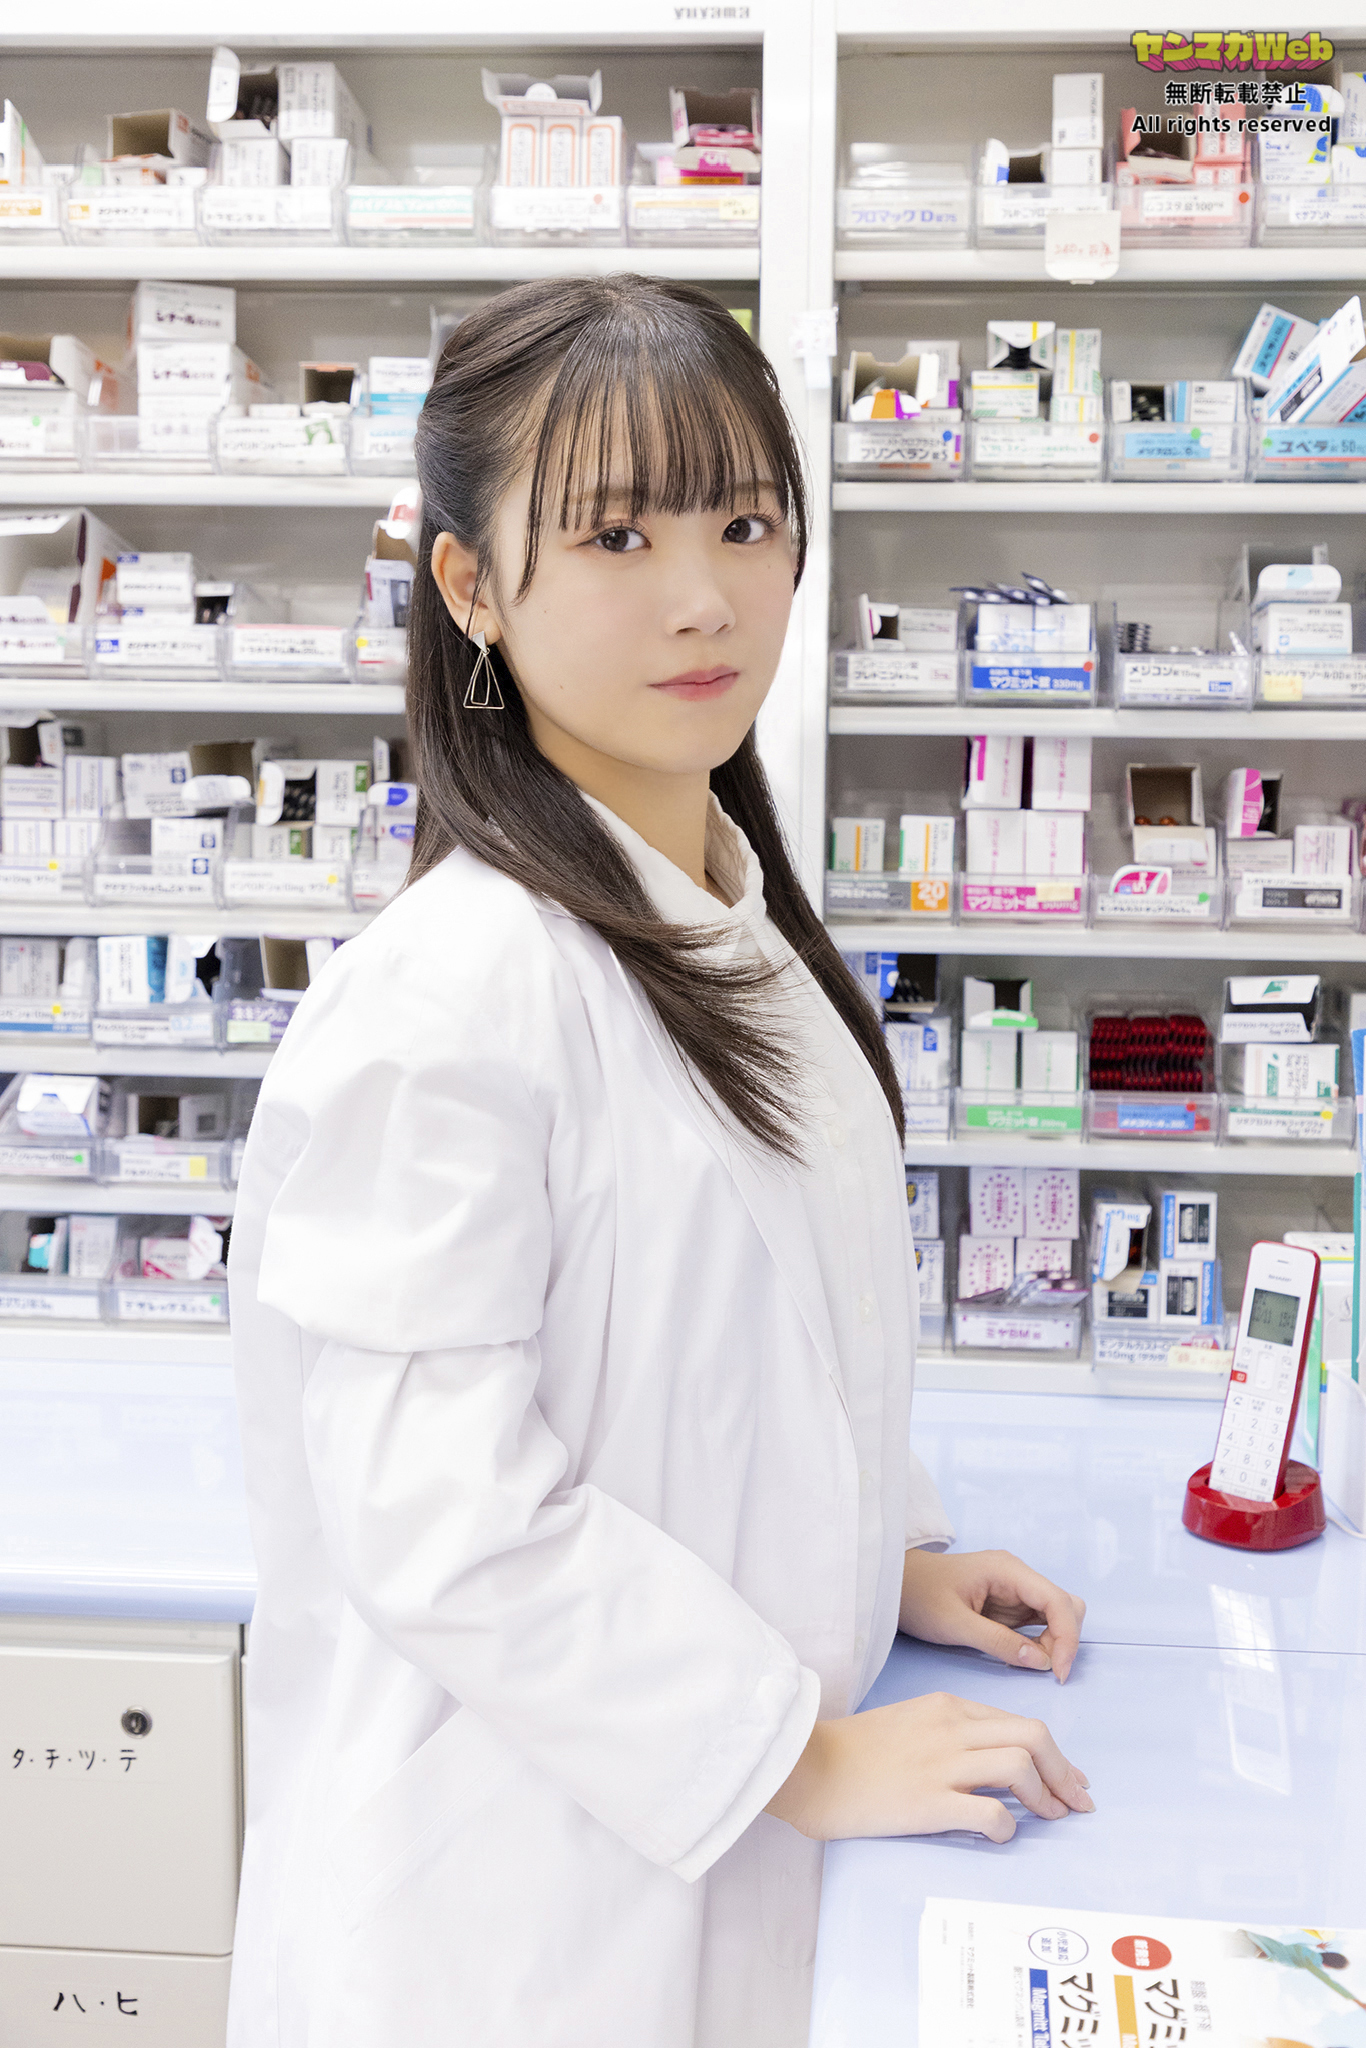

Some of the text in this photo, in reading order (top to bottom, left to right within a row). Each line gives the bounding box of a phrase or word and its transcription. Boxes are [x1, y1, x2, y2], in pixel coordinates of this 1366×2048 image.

[917, 881, 946, 901] 20
[1250, 1418, 1259, 1429] 2
[1271, 1423, 1279, 1435] 3
[1226, 1431, 1275, 1453] 4 5 6
[1222, 1448, 1272, 1470] 7 8 9
[1239, 1471, 1248, 1483] 0
[52, 1991, 138, 2016] ハ・ヒ
[1031, 1986, 1050, 2032] Magmitt
